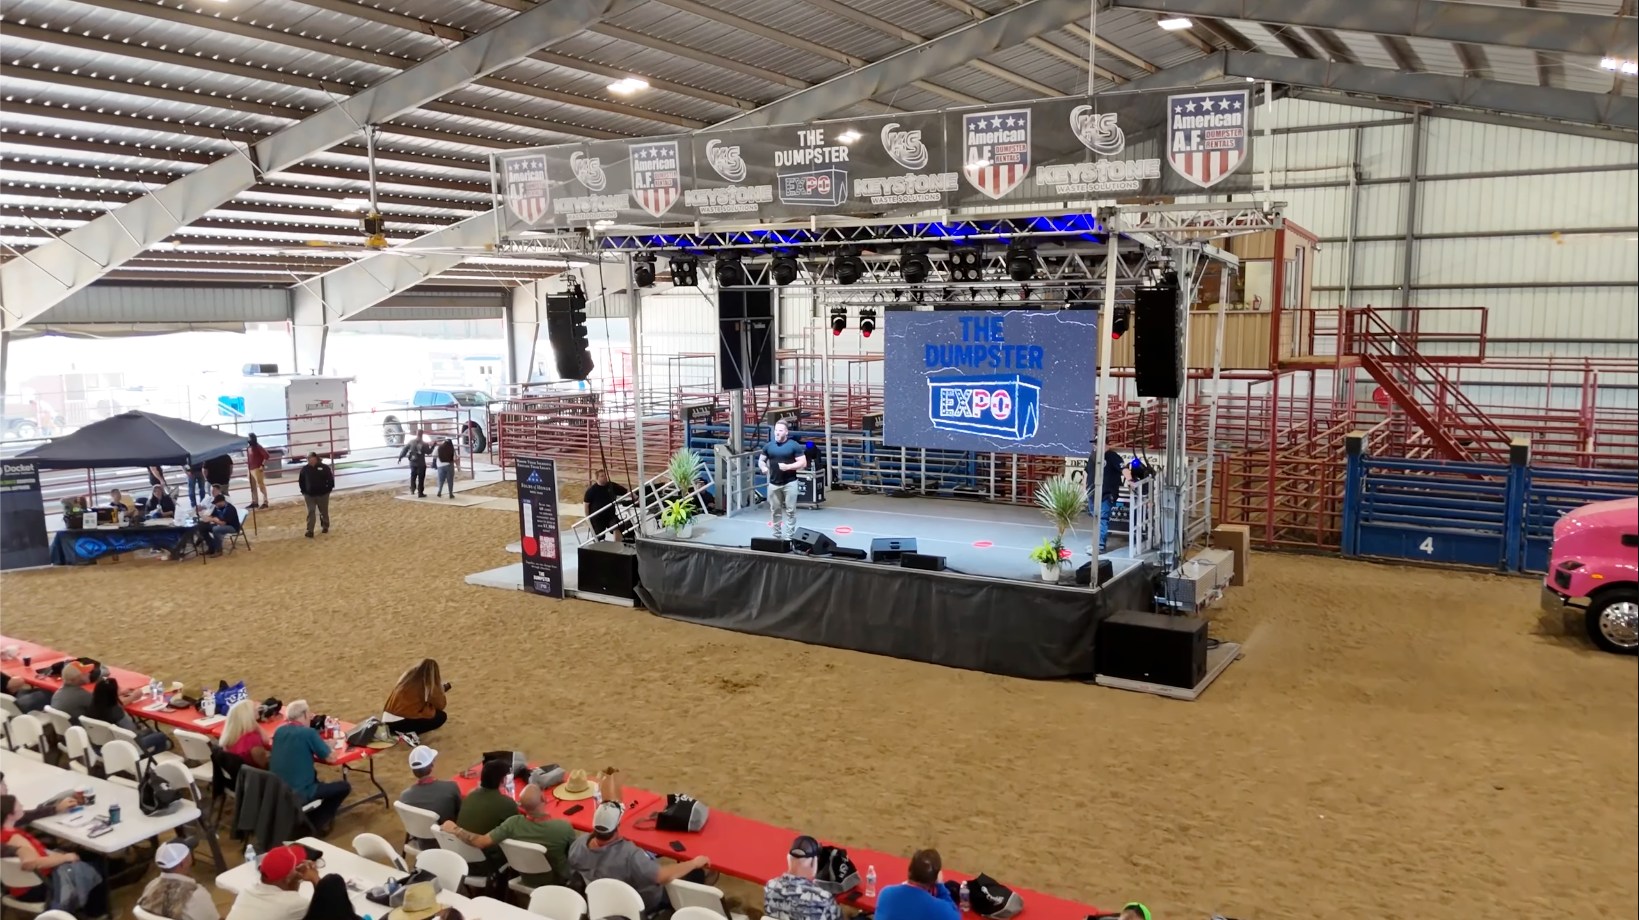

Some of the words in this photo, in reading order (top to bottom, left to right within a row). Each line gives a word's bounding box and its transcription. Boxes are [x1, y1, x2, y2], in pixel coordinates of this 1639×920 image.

[1173, 112, 1241, 130] American
[797, 129, 825, 147] THE
[968, 129, 1026, 146] American
[1172, 129, 1204, 152] A.F.
[1205, 128, 1244, 140] DUMPSTER
[994, 143, 1027, 154] DUMPSTER
[1205, 139, 1235, 150] RENTALS
[634, 158, 676, 171] American
[774, 146, 850, 167] DUMPSTER
[968, 145, 995, 166] A.F.
[994, 153, 1021, 163] RENTALS
[635, 171, 654, 189] A.F.
[1036, 159, 1161, 186] KEYSTONE
[785, 175, 831, 197] EXPO
[853, 172, 959, 198] KEYSTONE
[1056, 184, 1087, 194] WASTE
[1088, 181, 1139, 192] SOLUTIONS
[684, 184, 773, 207] KEYSTONE
[870, 195, 897, 206] WASTE
[898, 193, 941, 203] SOLUTIONS
[699, 205, 721, 214] WASTE
[721, 203, 759, 213] SOLUTIONS
[958, 316, 1005, 342] THE
[924, 343, 1044, 370] DUMPSTER
[939, 388, 1012, 420] EXPO
[3, 464, 35, 472] Docket
[1418, 536, 1434, 554] 4
